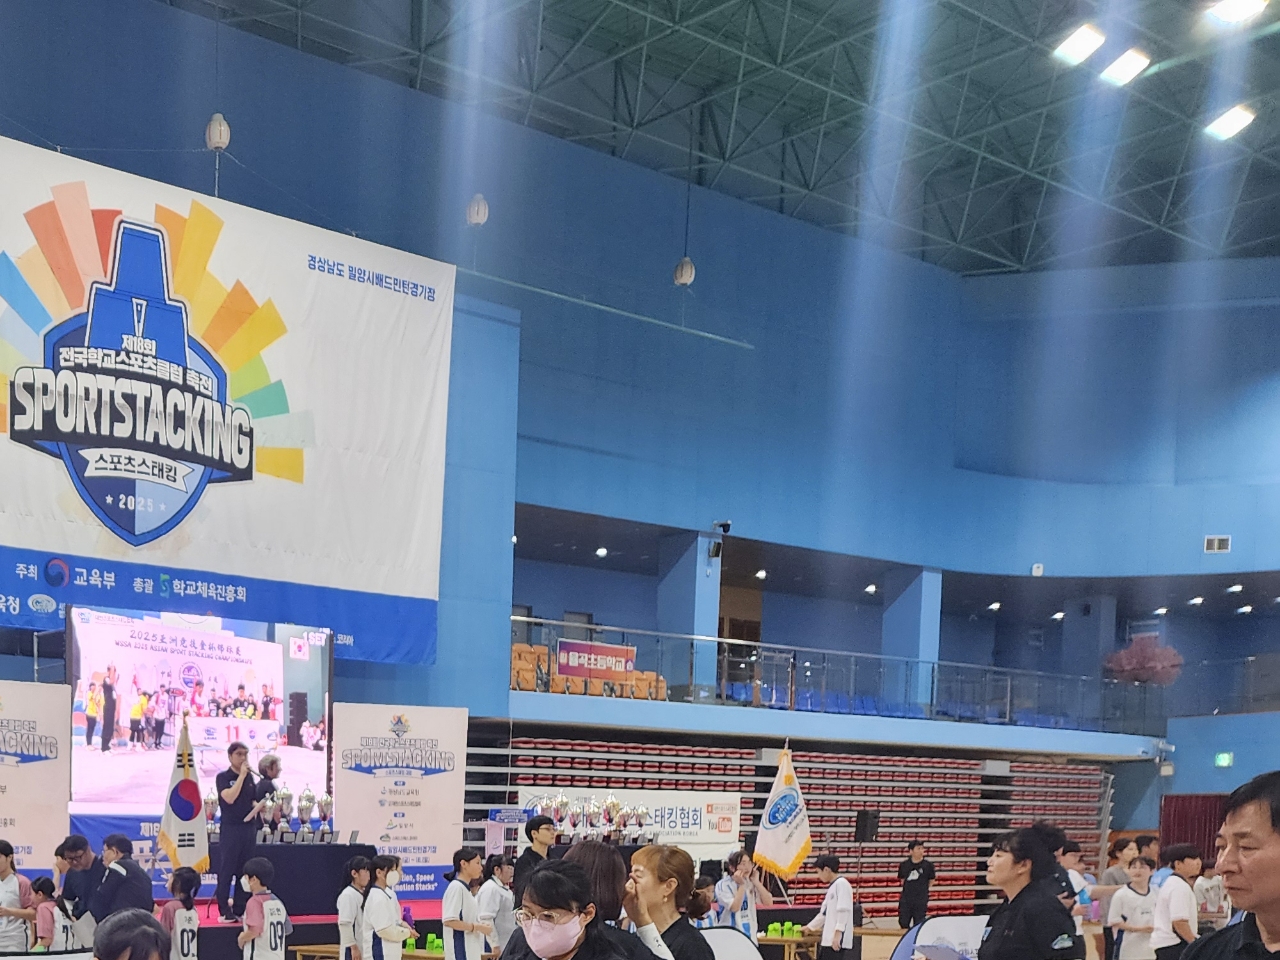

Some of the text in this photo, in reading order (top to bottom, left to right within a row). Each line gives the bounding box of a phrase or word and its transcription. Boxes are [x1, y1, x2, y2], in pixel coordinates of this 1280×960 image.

[308, 254, 436, 302] 경상남도 밀양시배드민턴경기장
[121, 334, 157, 356] 제18회
[59, 347, 214, 395] 전국학교스포츠클럽 축전
[14, 367, 251, 470] SPORTSTACKING
[94, 454, 178, 483] 스포츠스태킹
[118, 494, 154, 511] 2025
[15, 563, 38, 581] 주최
[74, 568, 116, 589] 교육부
[132, 577, 154, 594] 총괄
[172, 578, 247, 602] 학교체육진흥회
[342, 749, 455, 771] SPORTSTACKING
